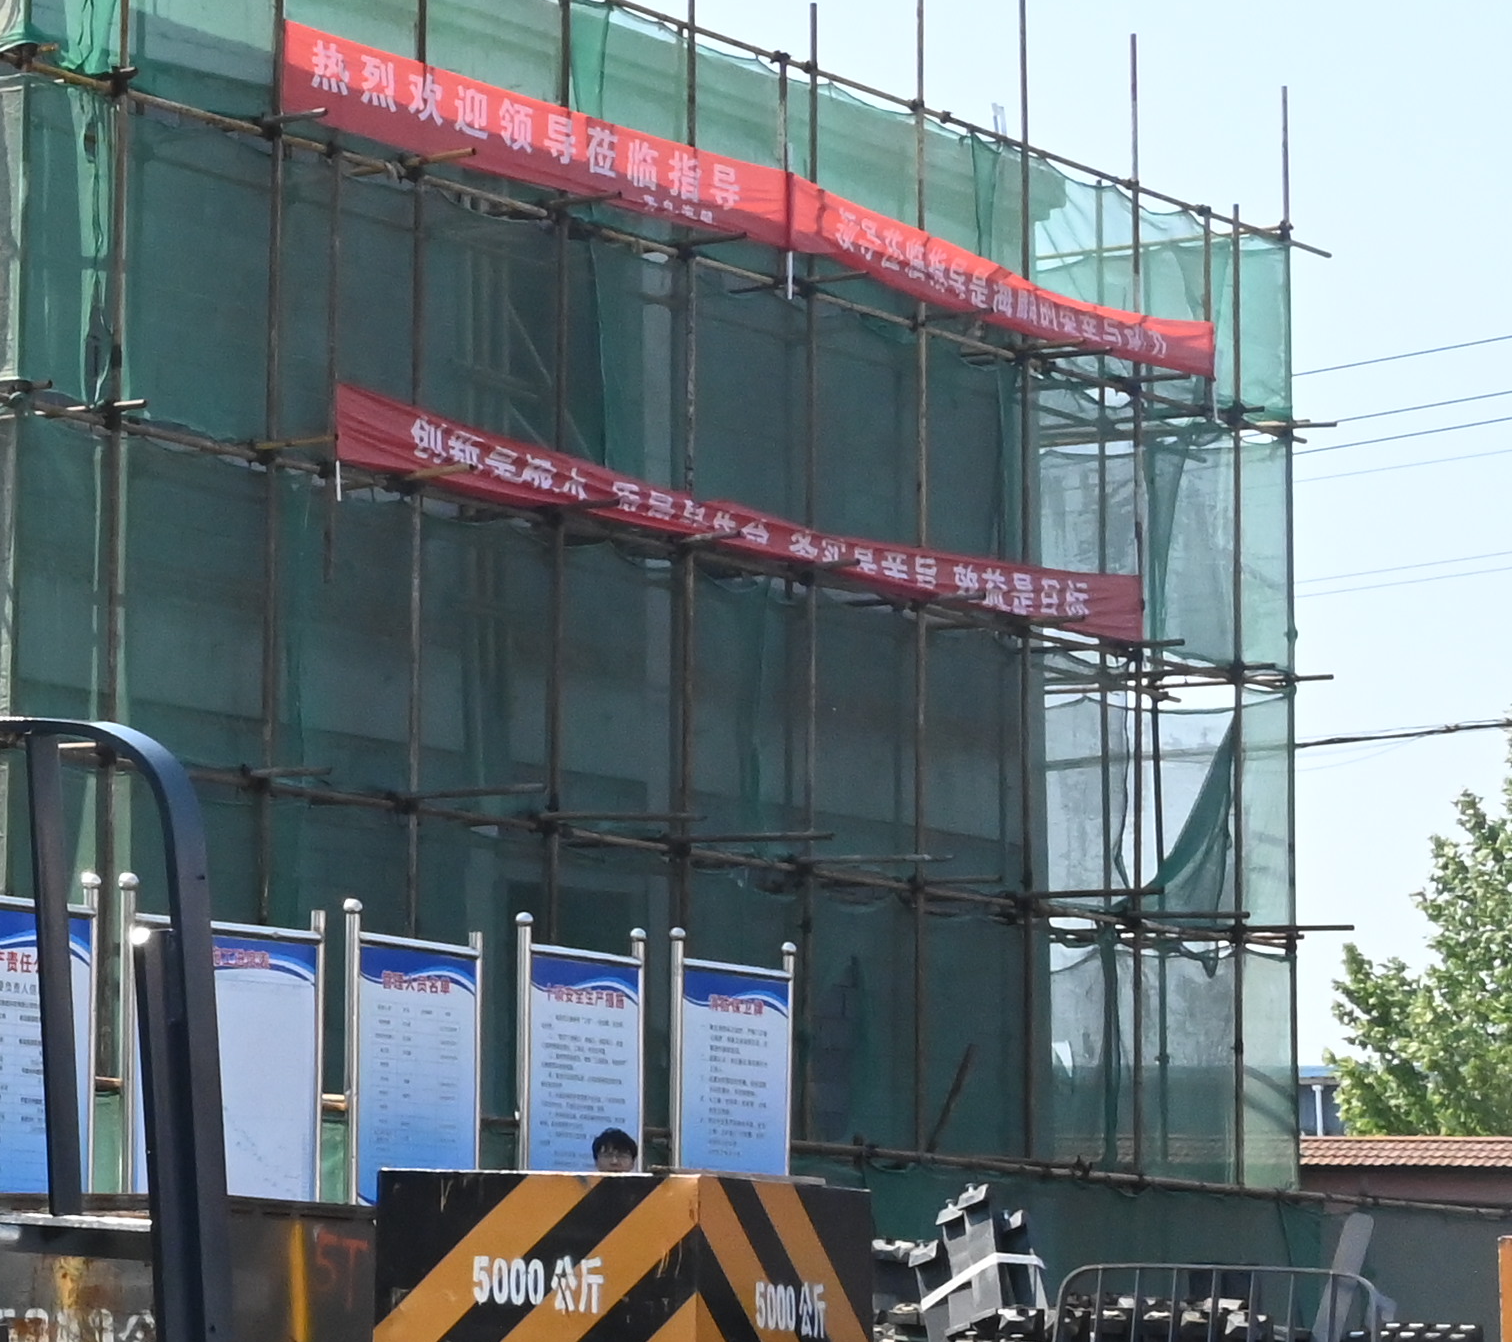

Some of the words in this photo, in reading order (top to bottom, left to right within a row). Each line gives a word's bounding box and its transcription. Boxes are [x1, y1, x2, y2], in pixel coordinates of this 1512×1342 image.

[310, 39, 742, 211] 热烈欢迎领导莅临指导
[473, 1255, 545, 1306] 5000
[551, 1255, 605, 1315] 公斤
[755, 1280, 795, 1332] 5000
[798, 1281, 827, 1339] 公斤
